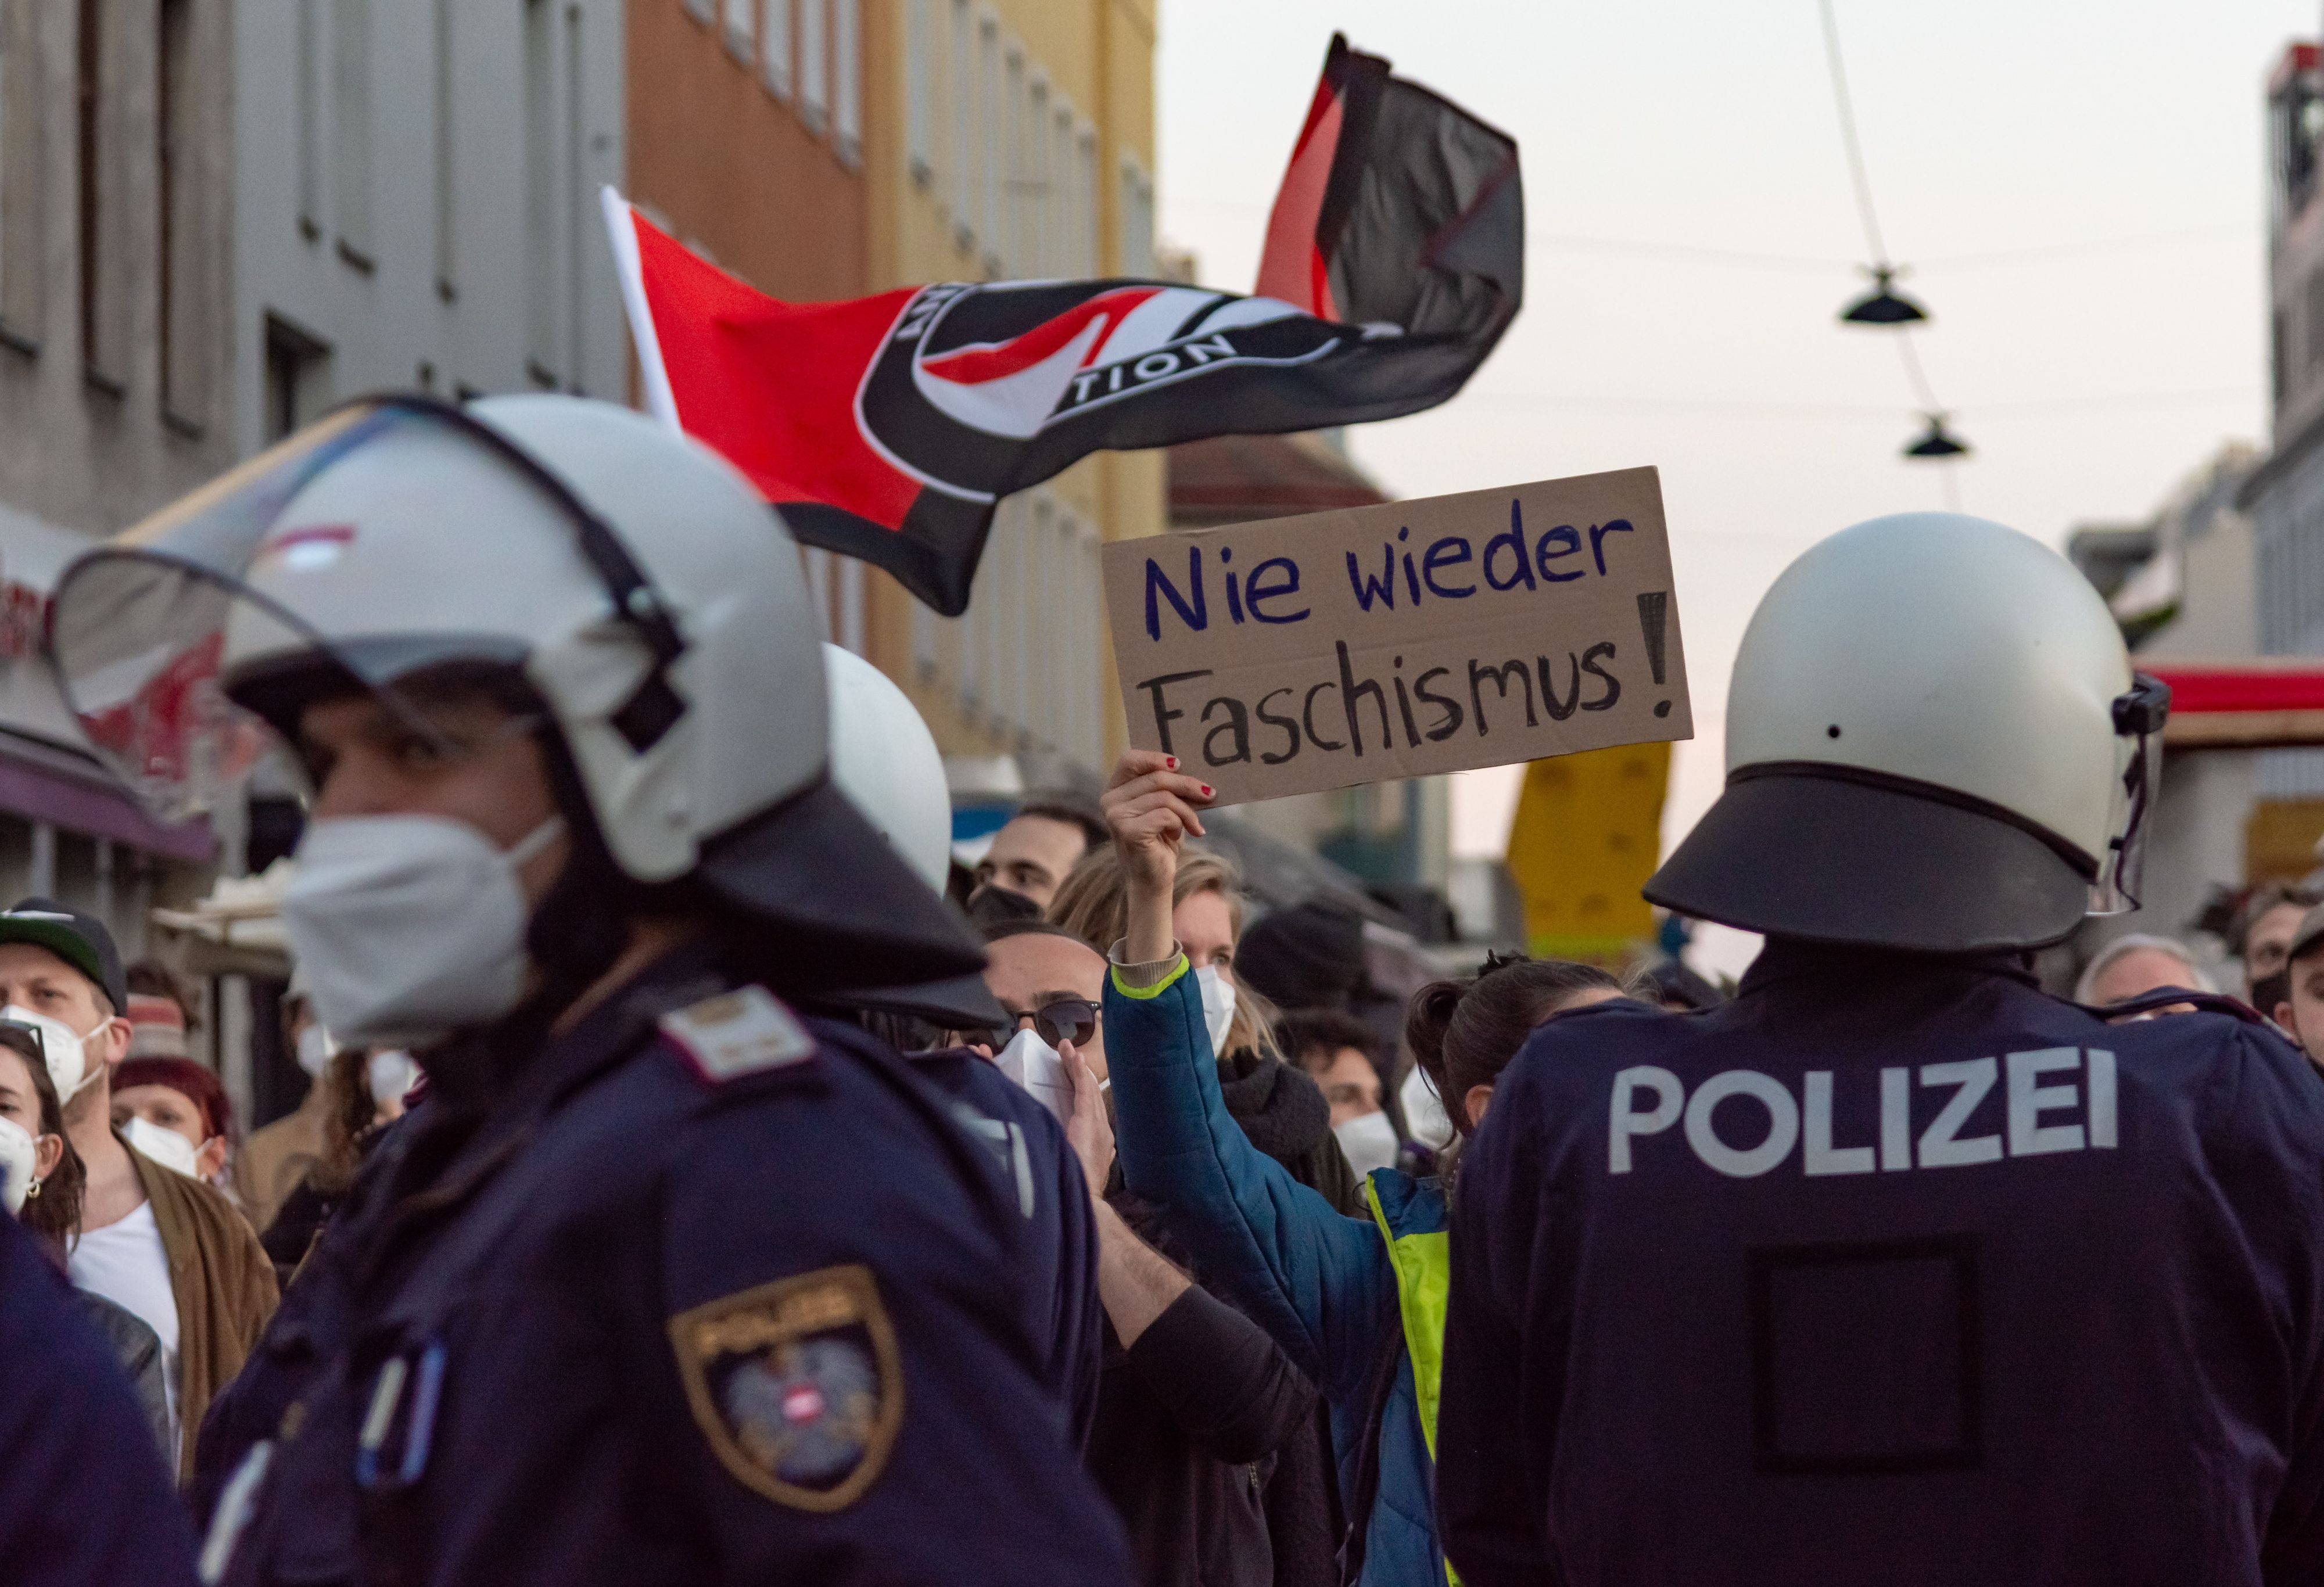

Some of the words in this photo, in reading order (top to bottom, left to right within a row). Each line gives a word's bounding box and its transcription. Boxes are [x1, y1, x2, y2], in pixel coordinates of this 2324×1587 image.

[1145, 545, 1311, 642] Nie
[1346, 498, 1633, 612] wieder
[1608, 1046, 2118, 1178] POLIZEI
